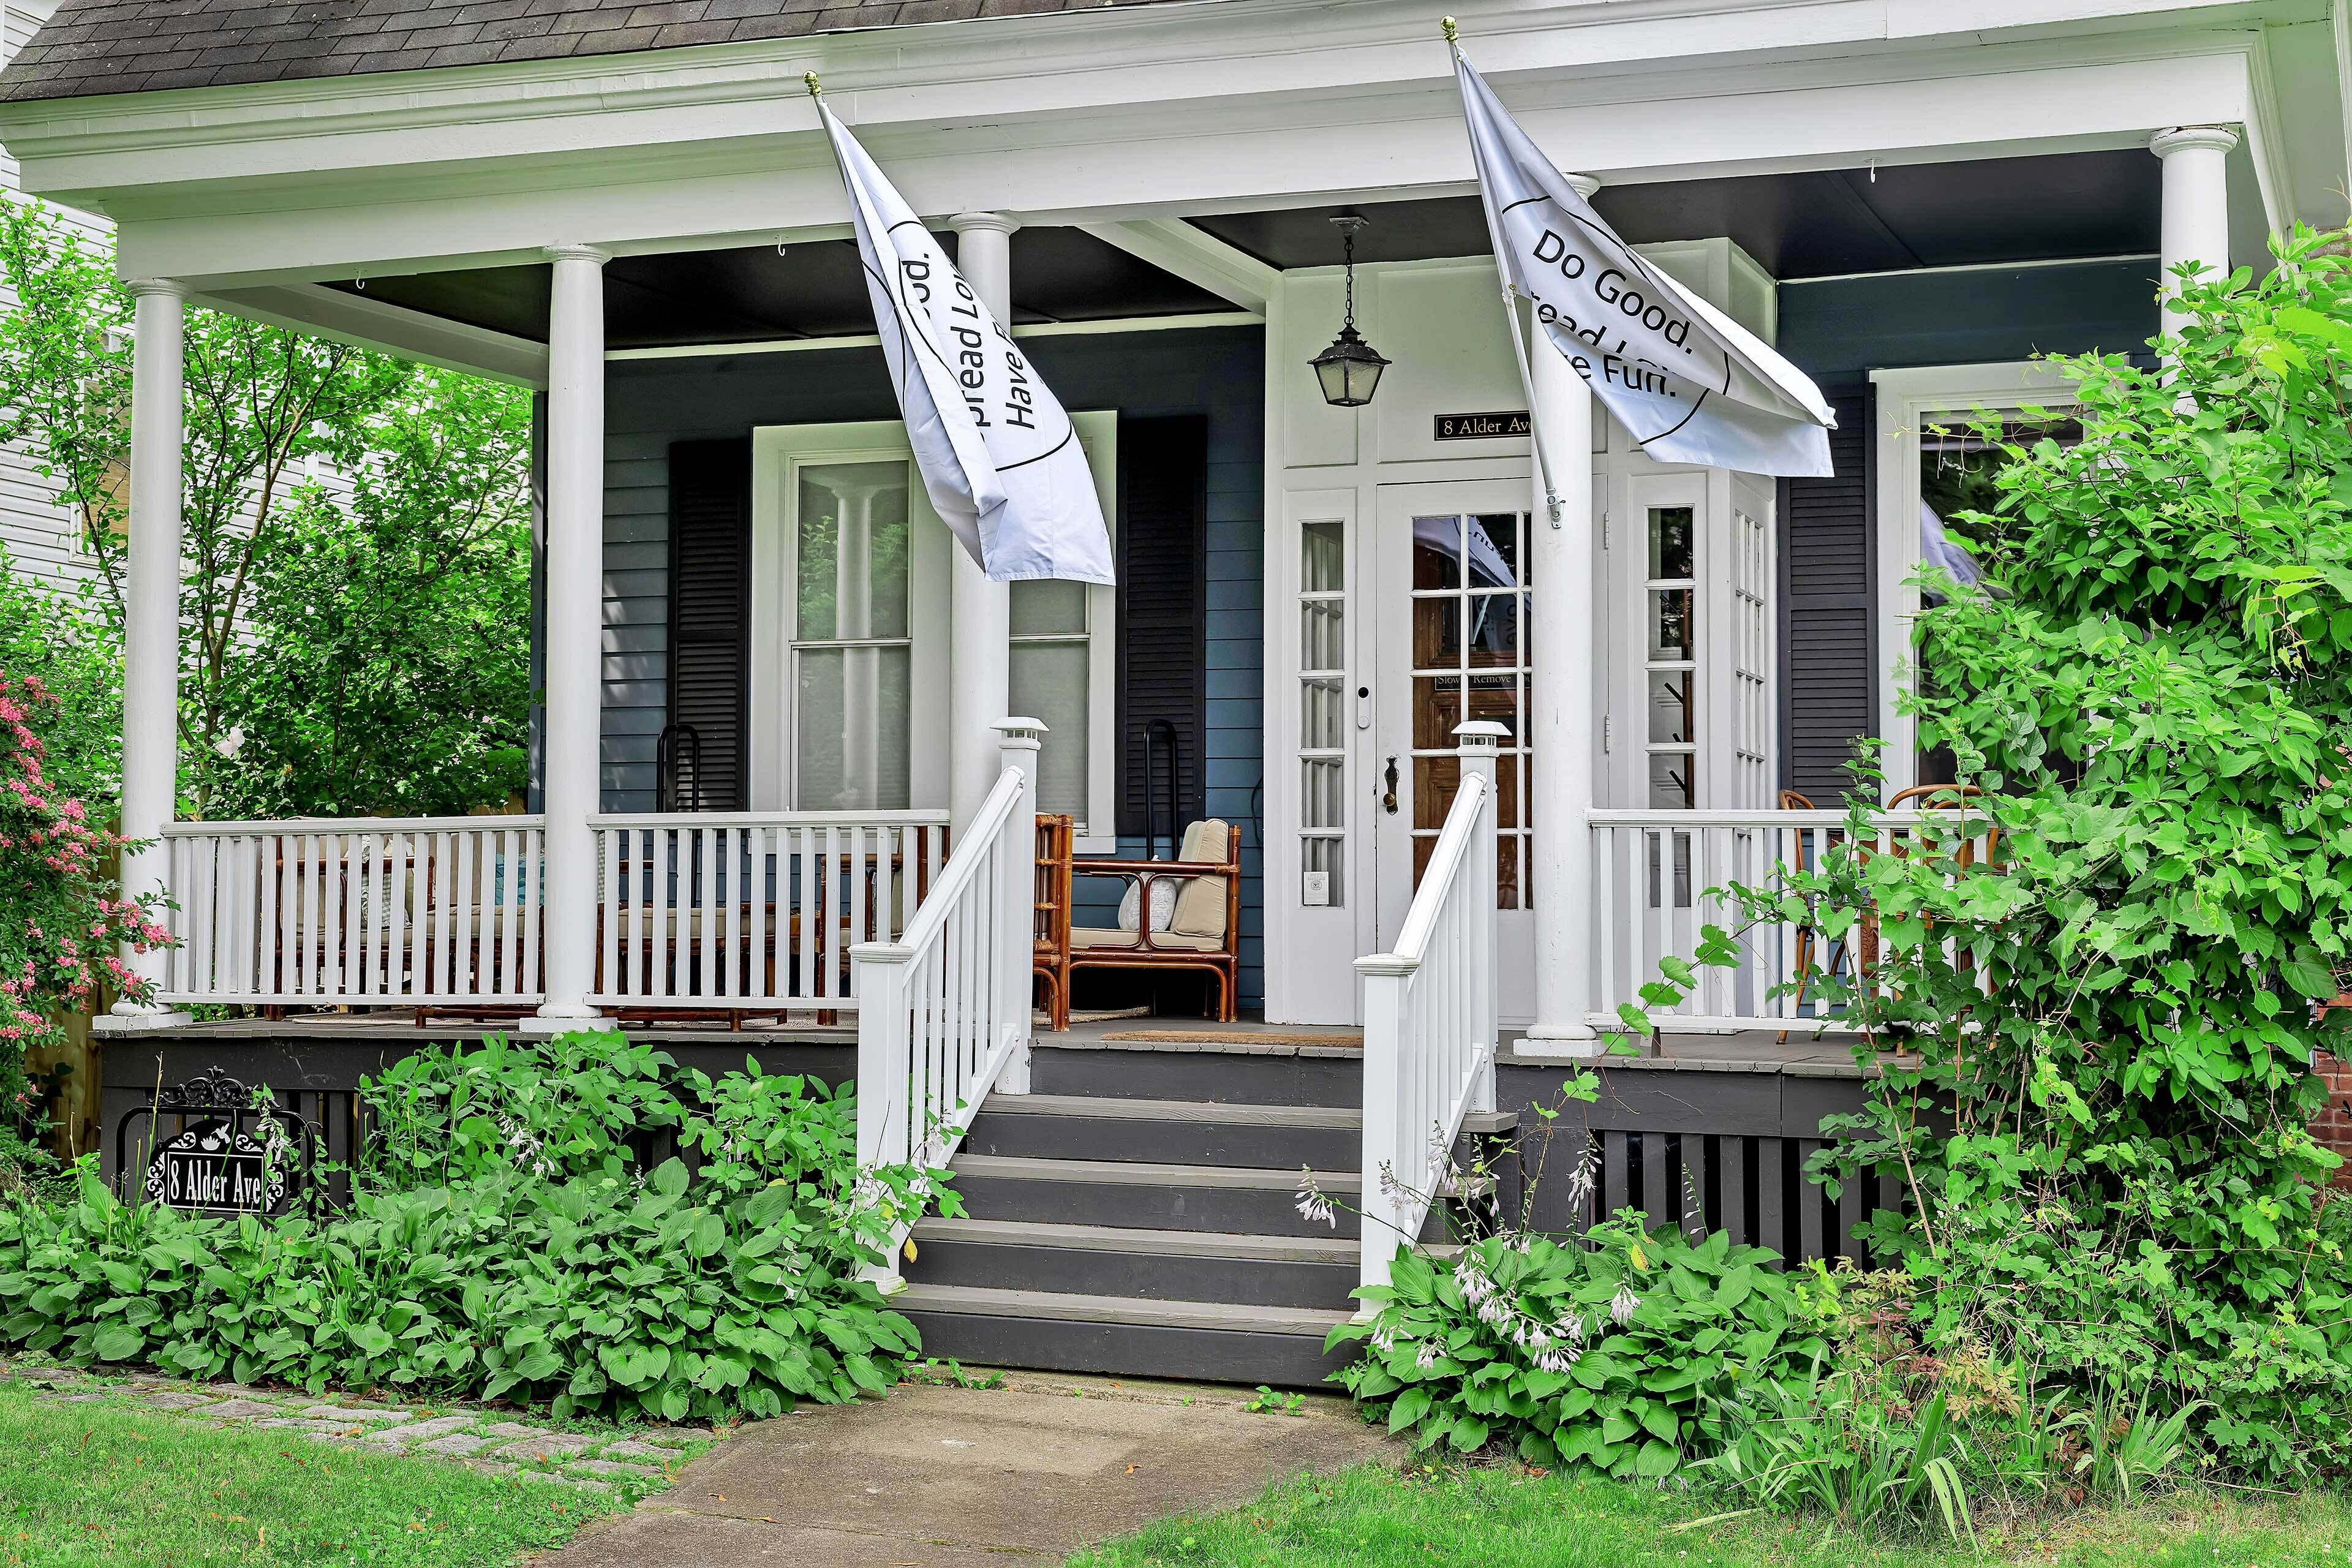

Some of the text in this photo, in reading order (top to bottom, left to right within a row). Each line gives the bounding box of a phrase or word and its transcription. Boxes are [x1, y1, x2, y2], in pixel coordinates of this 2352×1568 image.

[1532, 229, 1693, 354] Do Good.
[950, 326, 991, 442] pread
[1005, 351, 1035, 429] Have
[1603, 354, 1676, 398] Fun.
[1444, 420, 1453, 435] 8
[1459, 418, 1501, 434] Alder
[1473, 675, 1512, 684] Remove
[170, 1159, 261, 1204] 8 Alder Ave
